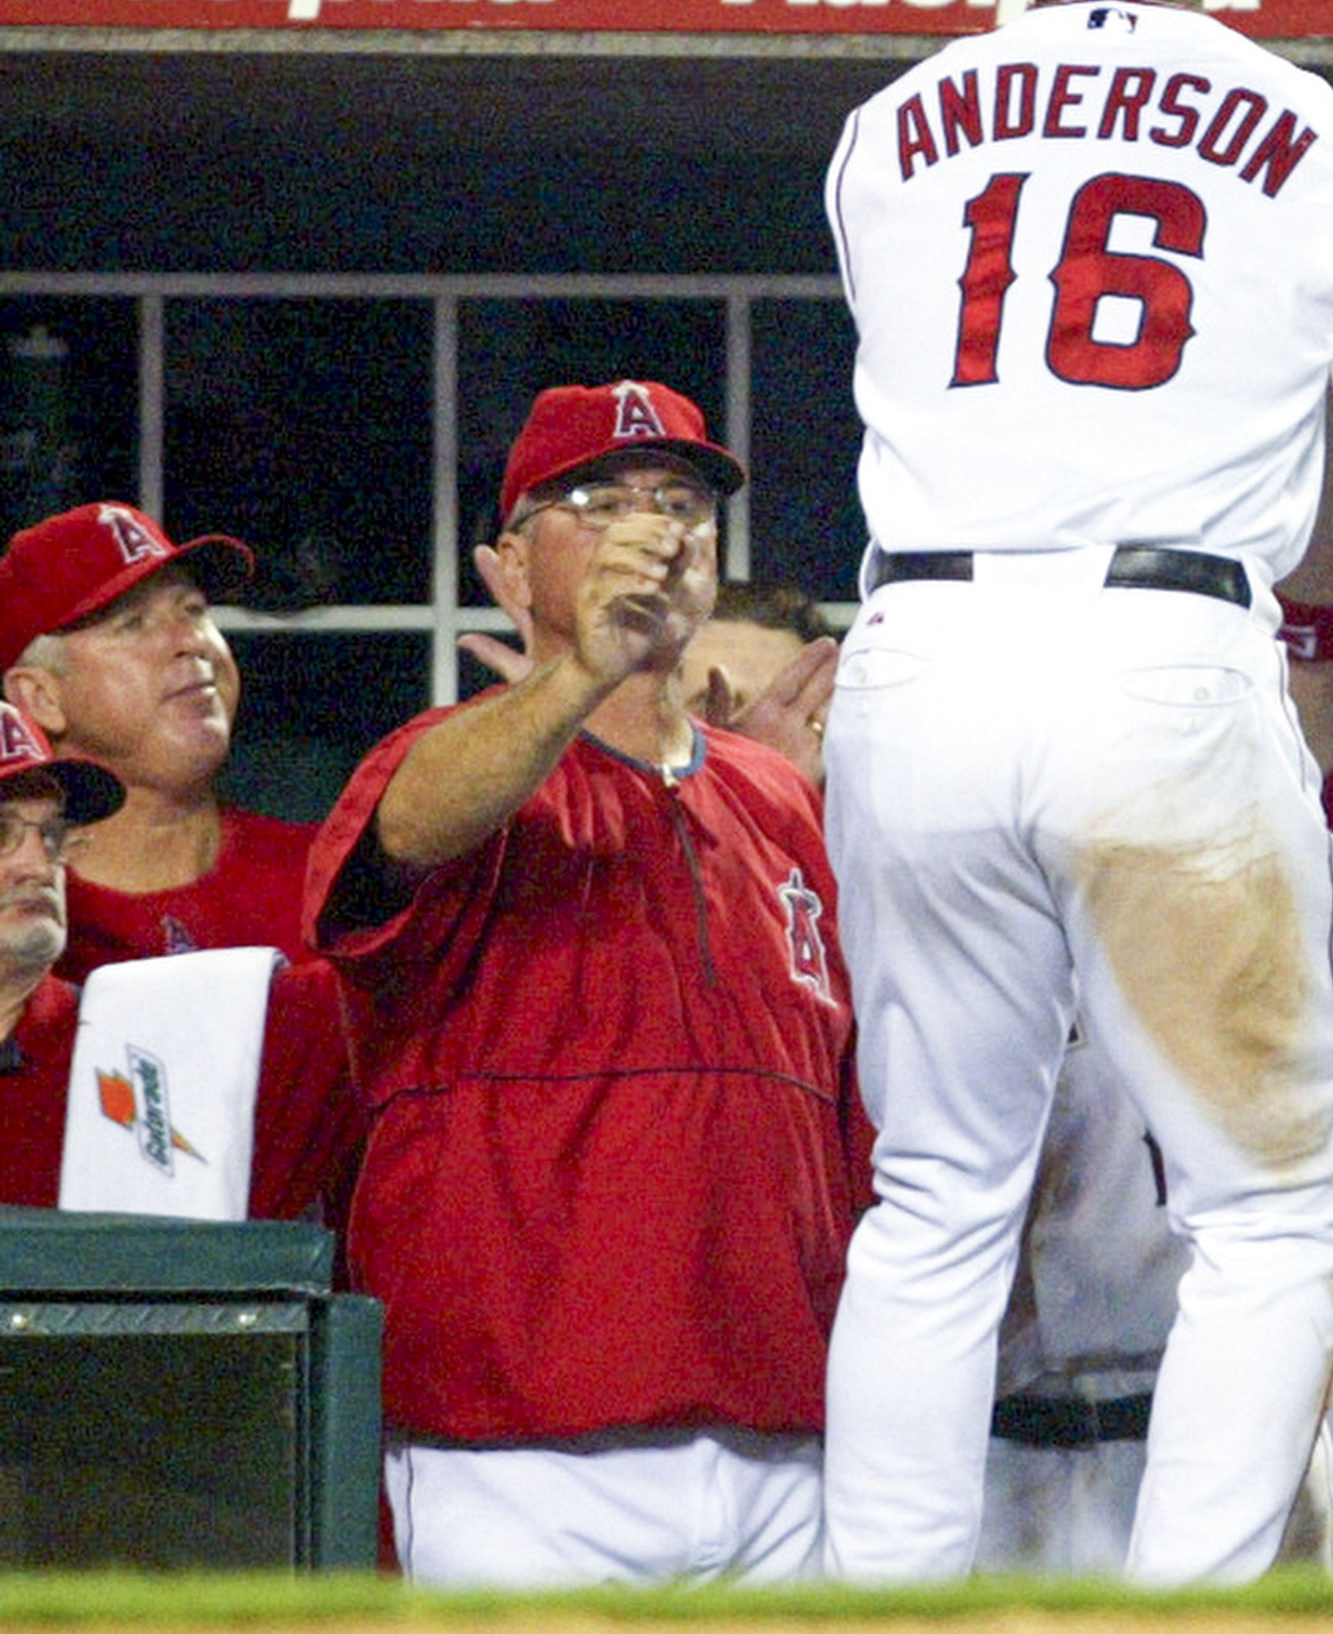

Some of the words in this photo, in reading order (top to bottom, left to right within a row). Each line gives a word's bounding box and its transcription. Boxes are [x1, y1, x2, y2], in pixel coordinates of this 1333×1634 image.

[897, 62, 1319, 199] ANDERSON
[946, 171, 1208, 392] 16
[613, 379, 666, 438] A
[98, 501, 168, 565] A
